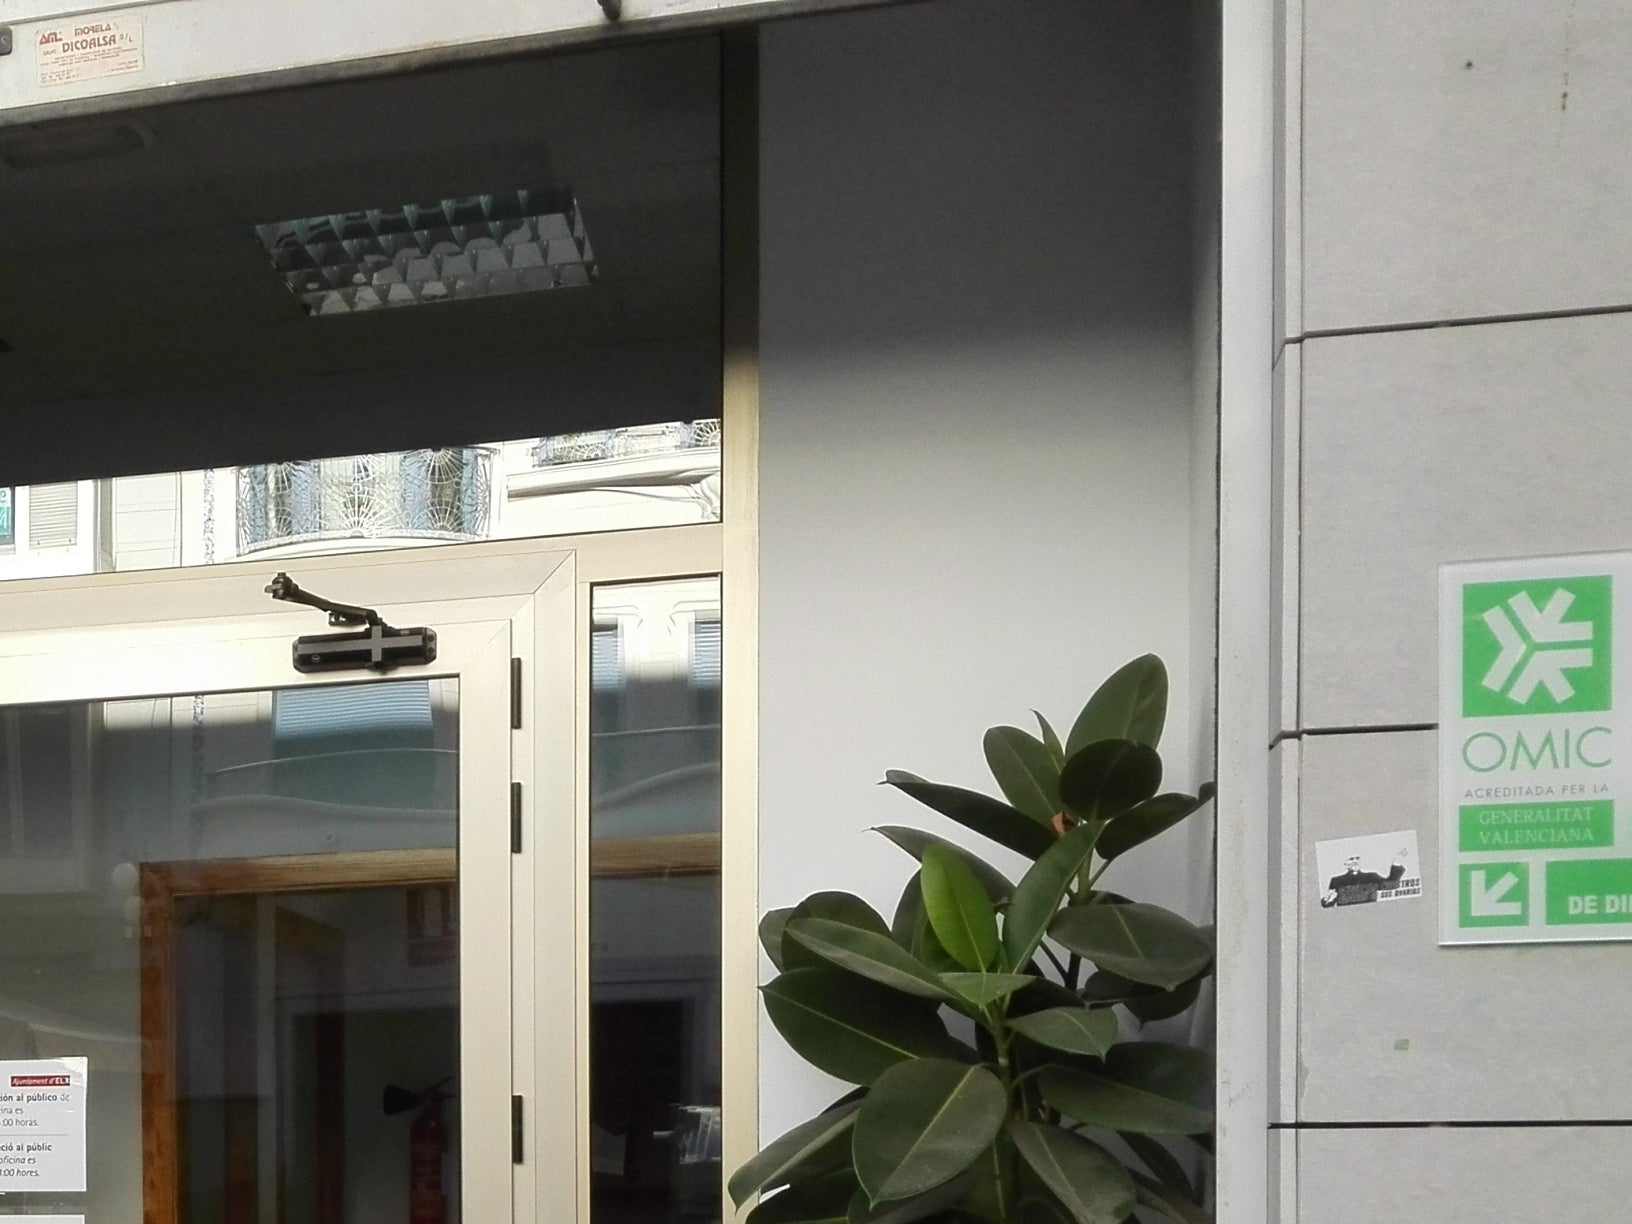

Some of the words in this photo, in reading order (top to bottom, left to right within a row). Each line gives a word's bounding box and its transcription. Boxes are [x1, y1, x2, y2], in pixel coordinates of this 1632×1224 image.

[62, 34, 117, 53] DICOALSA
[1462, 726, 1612, 773] OMIC
[1464, 786, 1554, 799] ACREDITADA
[1562, 784, 1586, 794] PER
[1593, 783, 1609, 794] LA
[1479, 806, 1594, 825] GENERALITAT
[1480, 828, 1594, 844] VALENCIANA
[1569, 895, 1599, 915] DE
[1605, 893, 1632, 914] DI
[16, 1093, 24, 1102] al
[26, 1092, 58, 1103] público
[60, 1093, 70, 1102] de
[15, 1107, 24, 1115] es
[16, 1142, 24, 1152] al
[26, 1142, 53, 1153] públic
